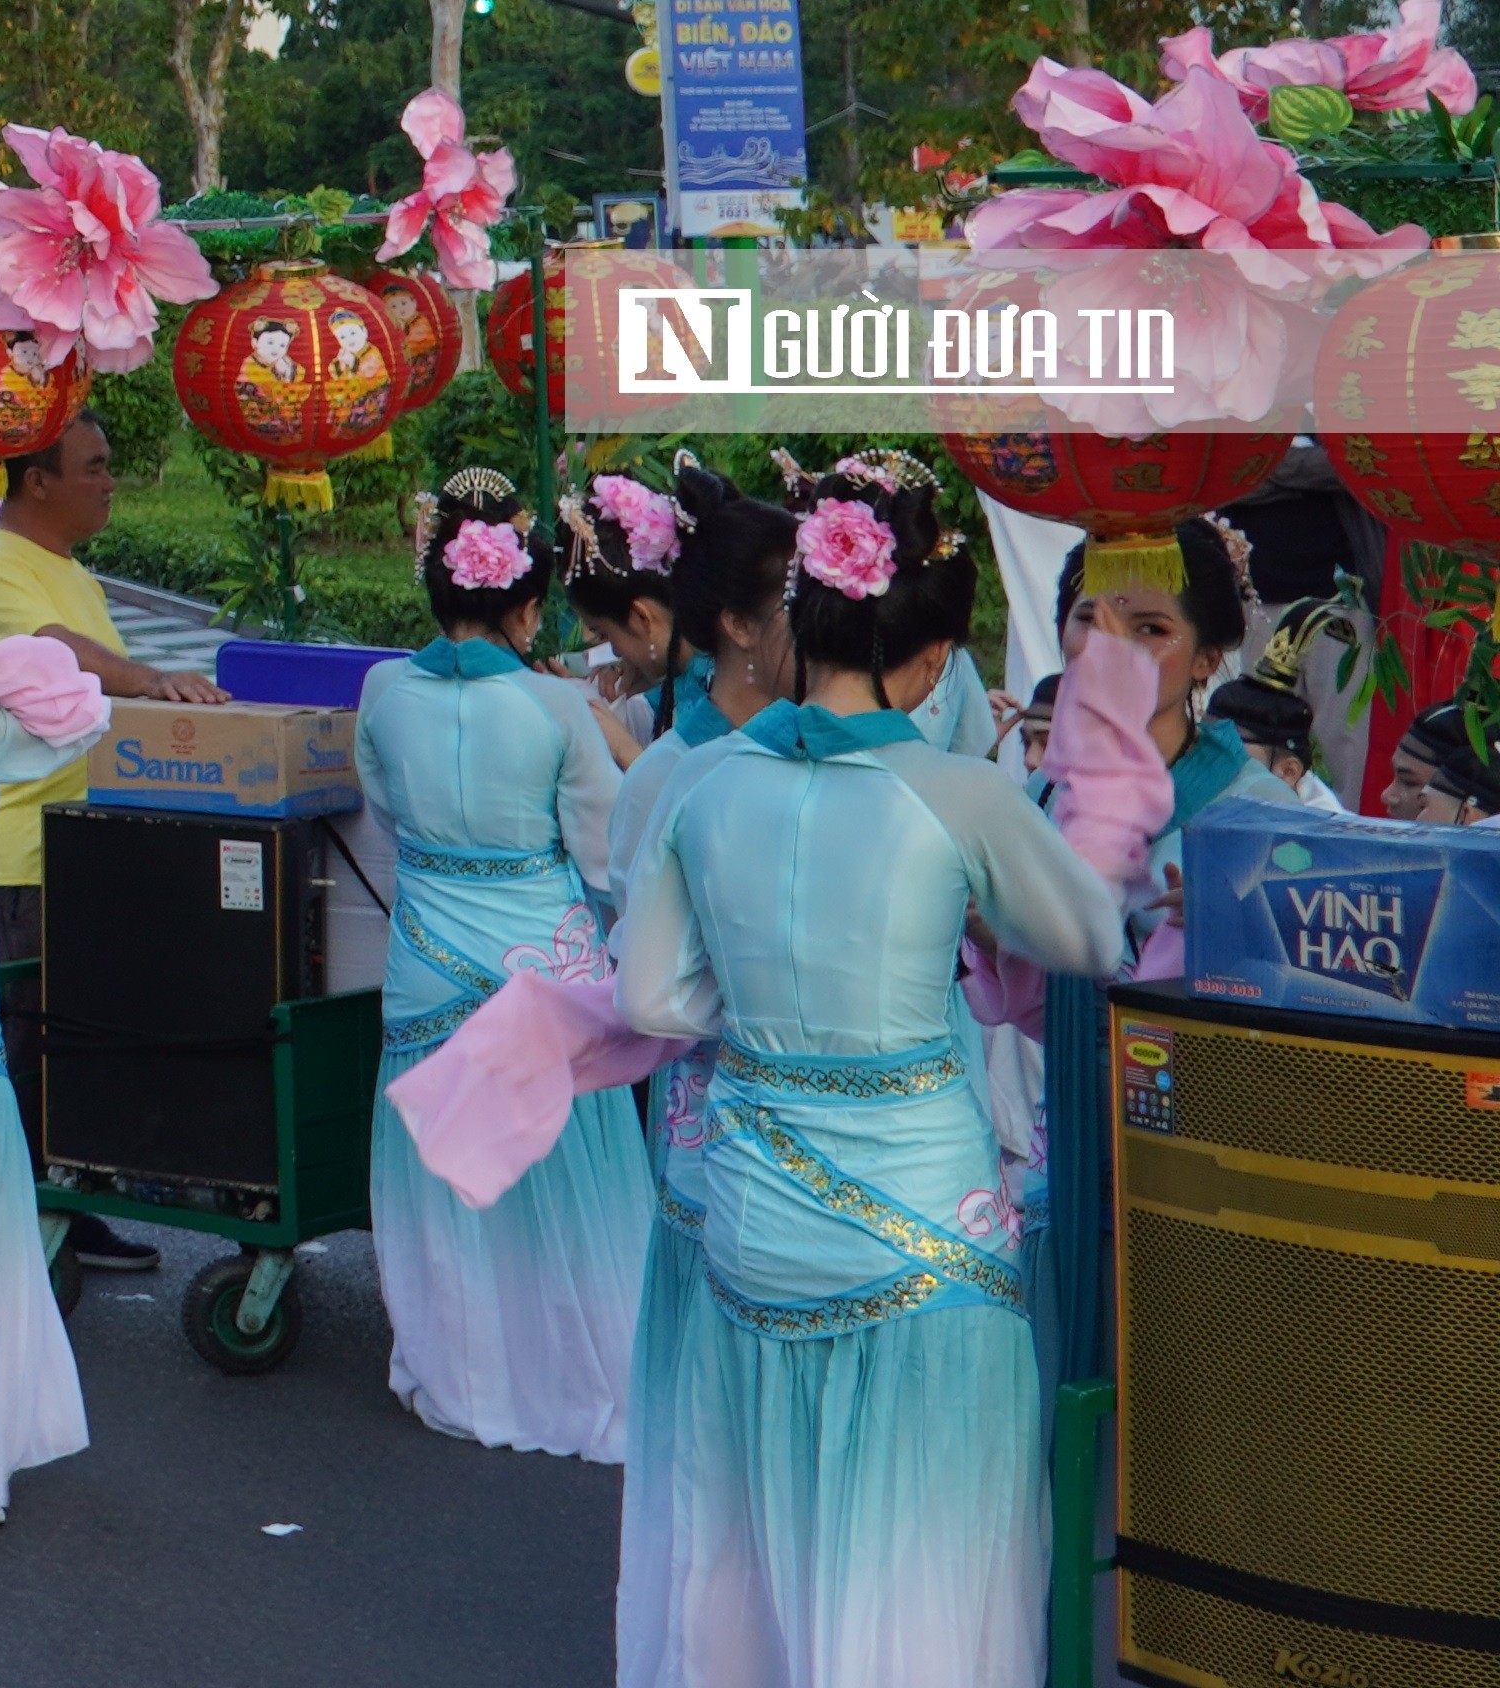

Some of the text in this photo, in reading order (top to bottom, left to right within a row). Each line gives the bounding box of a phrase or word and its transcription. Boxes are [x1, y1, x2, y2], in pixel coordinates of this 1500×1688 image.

[740, 15, 793, 44] ĐẢO
[678, 46, 795, 78] VIỆT NAM
[114, 738, 224, 785] Sanna
[1286, 882, 1405, 936] VĨNH
